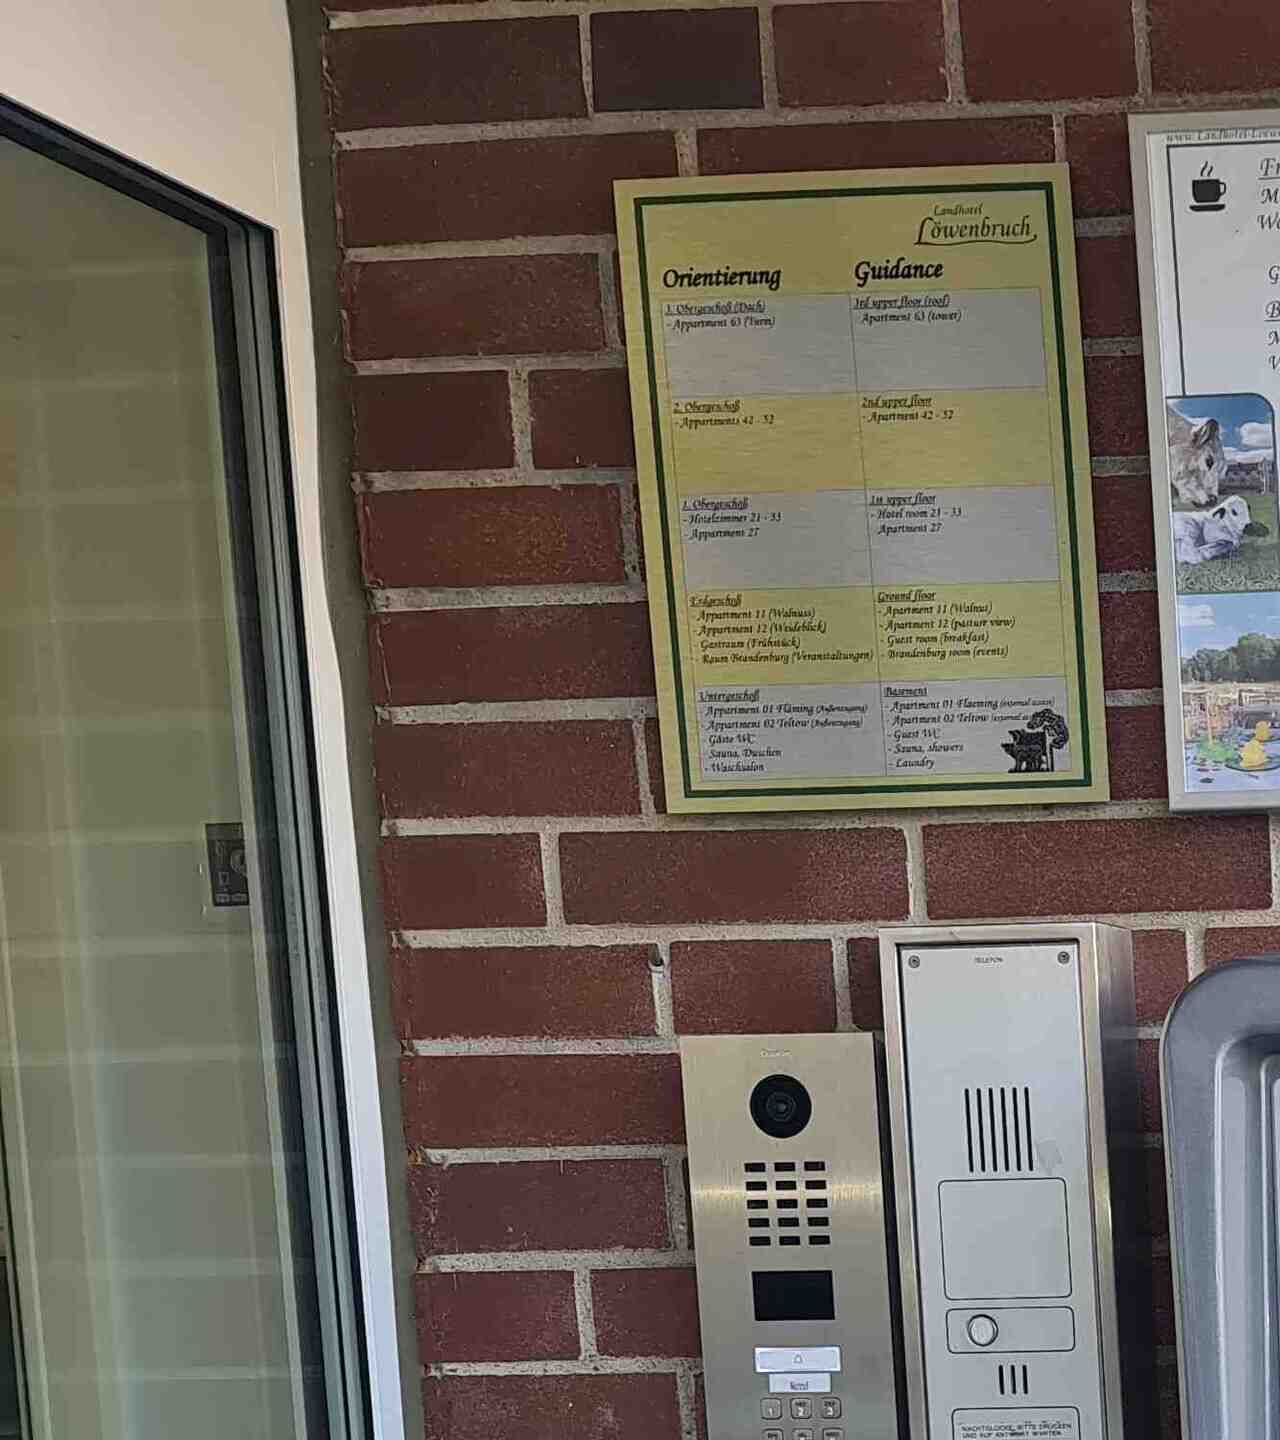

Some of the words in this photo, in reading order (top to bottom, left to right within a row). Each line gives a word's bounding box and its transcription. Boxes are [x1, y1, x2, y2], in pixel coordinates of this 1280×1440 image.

[915, 217, 1037, 246] Löwenbruch
[662, 266, 781, 290] Orientierung
[854, 259, 944, 287] Guidance
